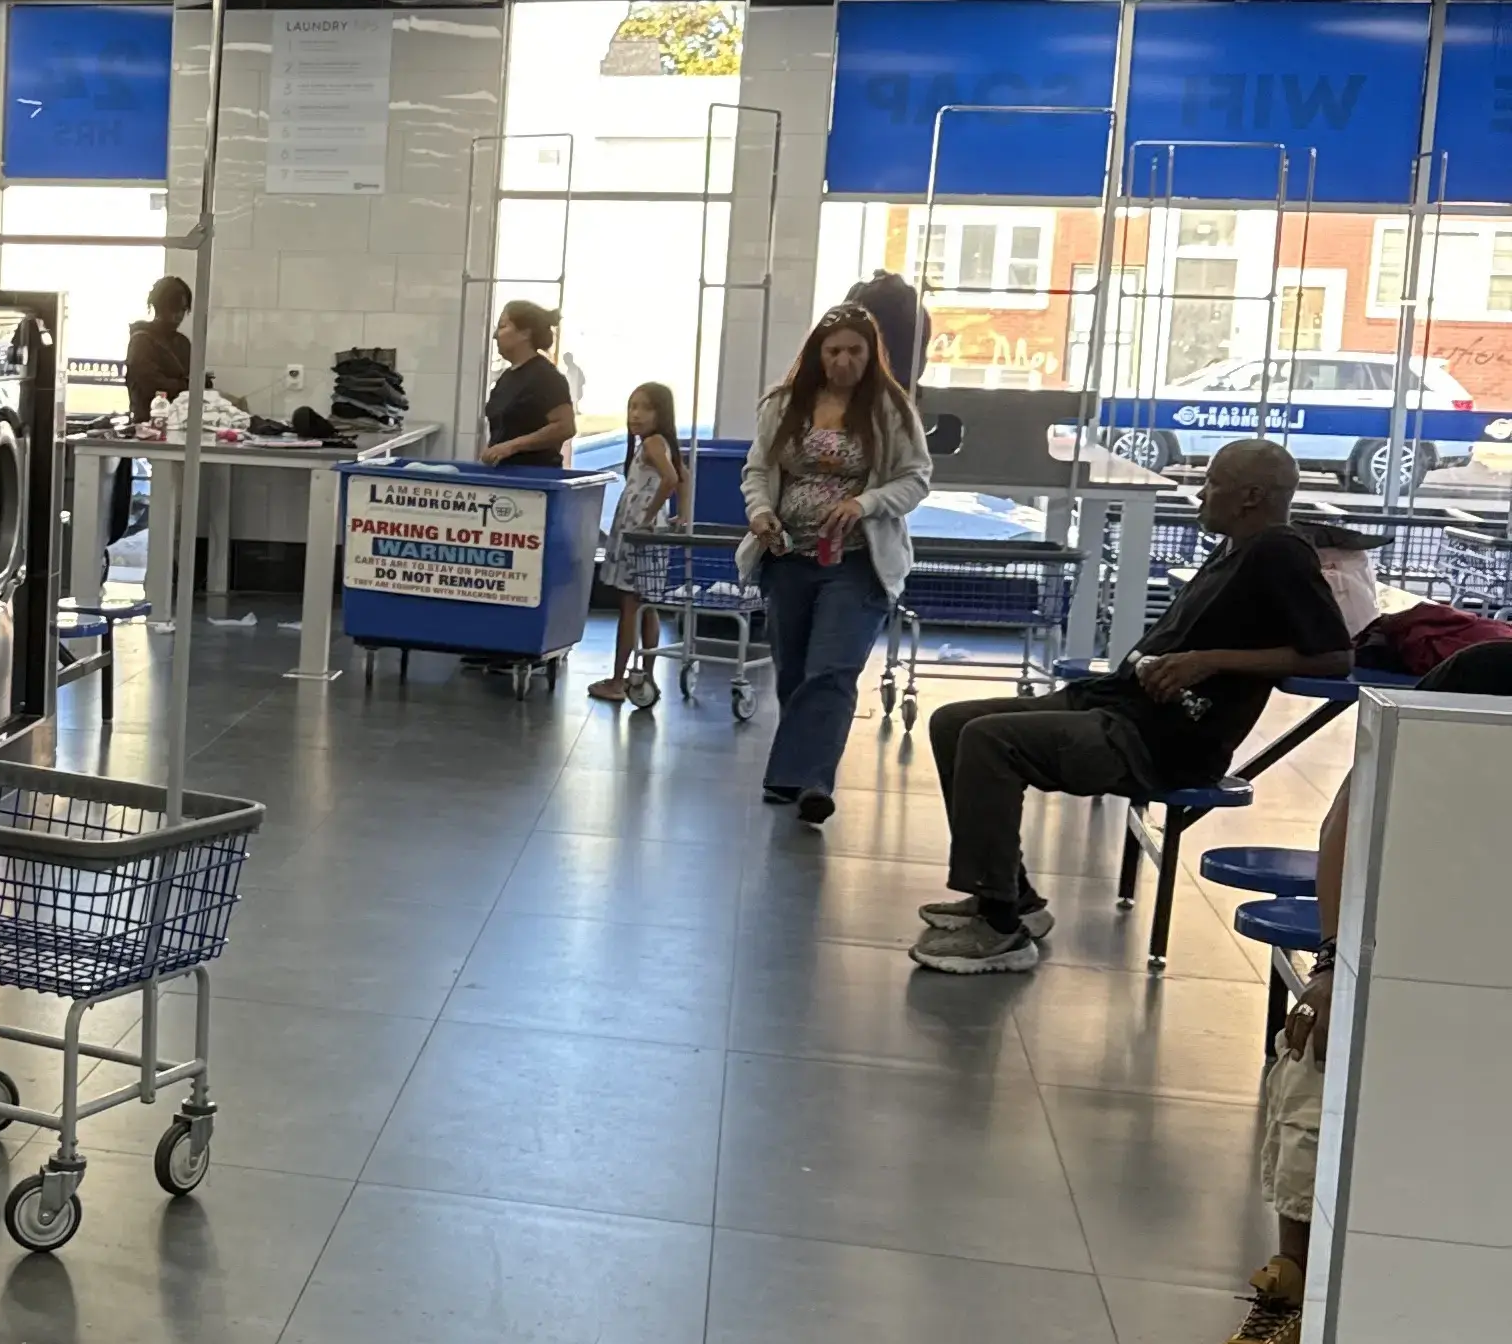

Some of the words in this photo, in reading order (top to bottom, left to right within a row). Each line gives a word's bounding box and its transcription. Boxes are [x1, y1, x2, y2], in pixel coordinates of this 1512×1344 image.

[285, 20, 348, 32] LAUNDRY
[385, 484, 477, 501] AMERICAN
[369, 484, 492, 527] LAUNDROMAT
[350, 517, 439, 541] PARKING
[445, 527, 483, 545] LOT
[489, 531, 541, 550] BINS
[377, 539, 507, 567] WARNING
[354, 555, 387, 566] CARTS
[390, 560, 408, 569] ARE
[412, 561, 424, 570] TO
[427, 563, 454, 574] STAY
[457, 566, 472, 576] ON
[474, 568, 528, 581] PROPERTY
[375, 567, 397, 580] DO
[402, 570, 434, 584] NOT
[438, 574, 506, 592] REMOVE
[354, 577, 373, 585] THEY
